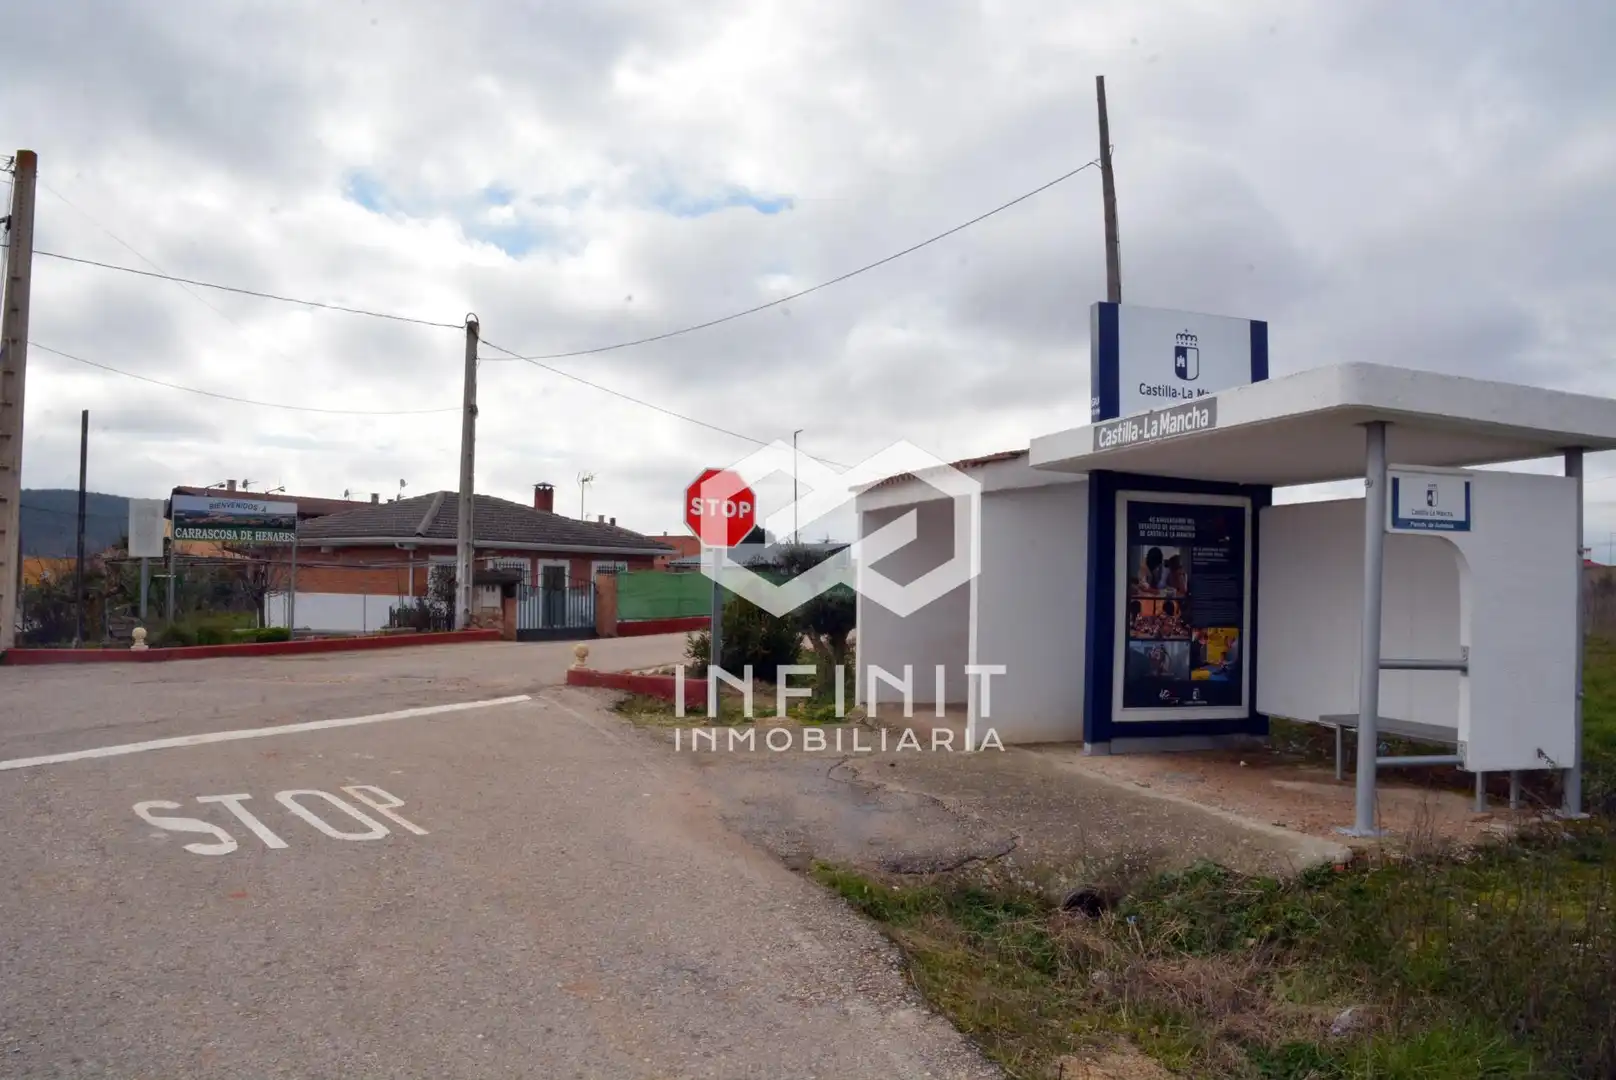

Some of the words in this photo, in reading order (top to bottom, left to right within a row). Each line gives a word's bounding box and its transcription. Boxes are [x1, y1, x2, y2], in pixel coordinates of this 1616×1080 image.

[1160, 405, 1209, 436] Mancha
[208, 501, 258, 512] BIENVENIDOS
[690, 497, 751, 519] STOP
[175, 527, 238, 541] CARRASCOSA
[240, 530, 253, 541] DE
[255, 531, 295, 542] HENARES
[132, 784, 429, 856] STOP
